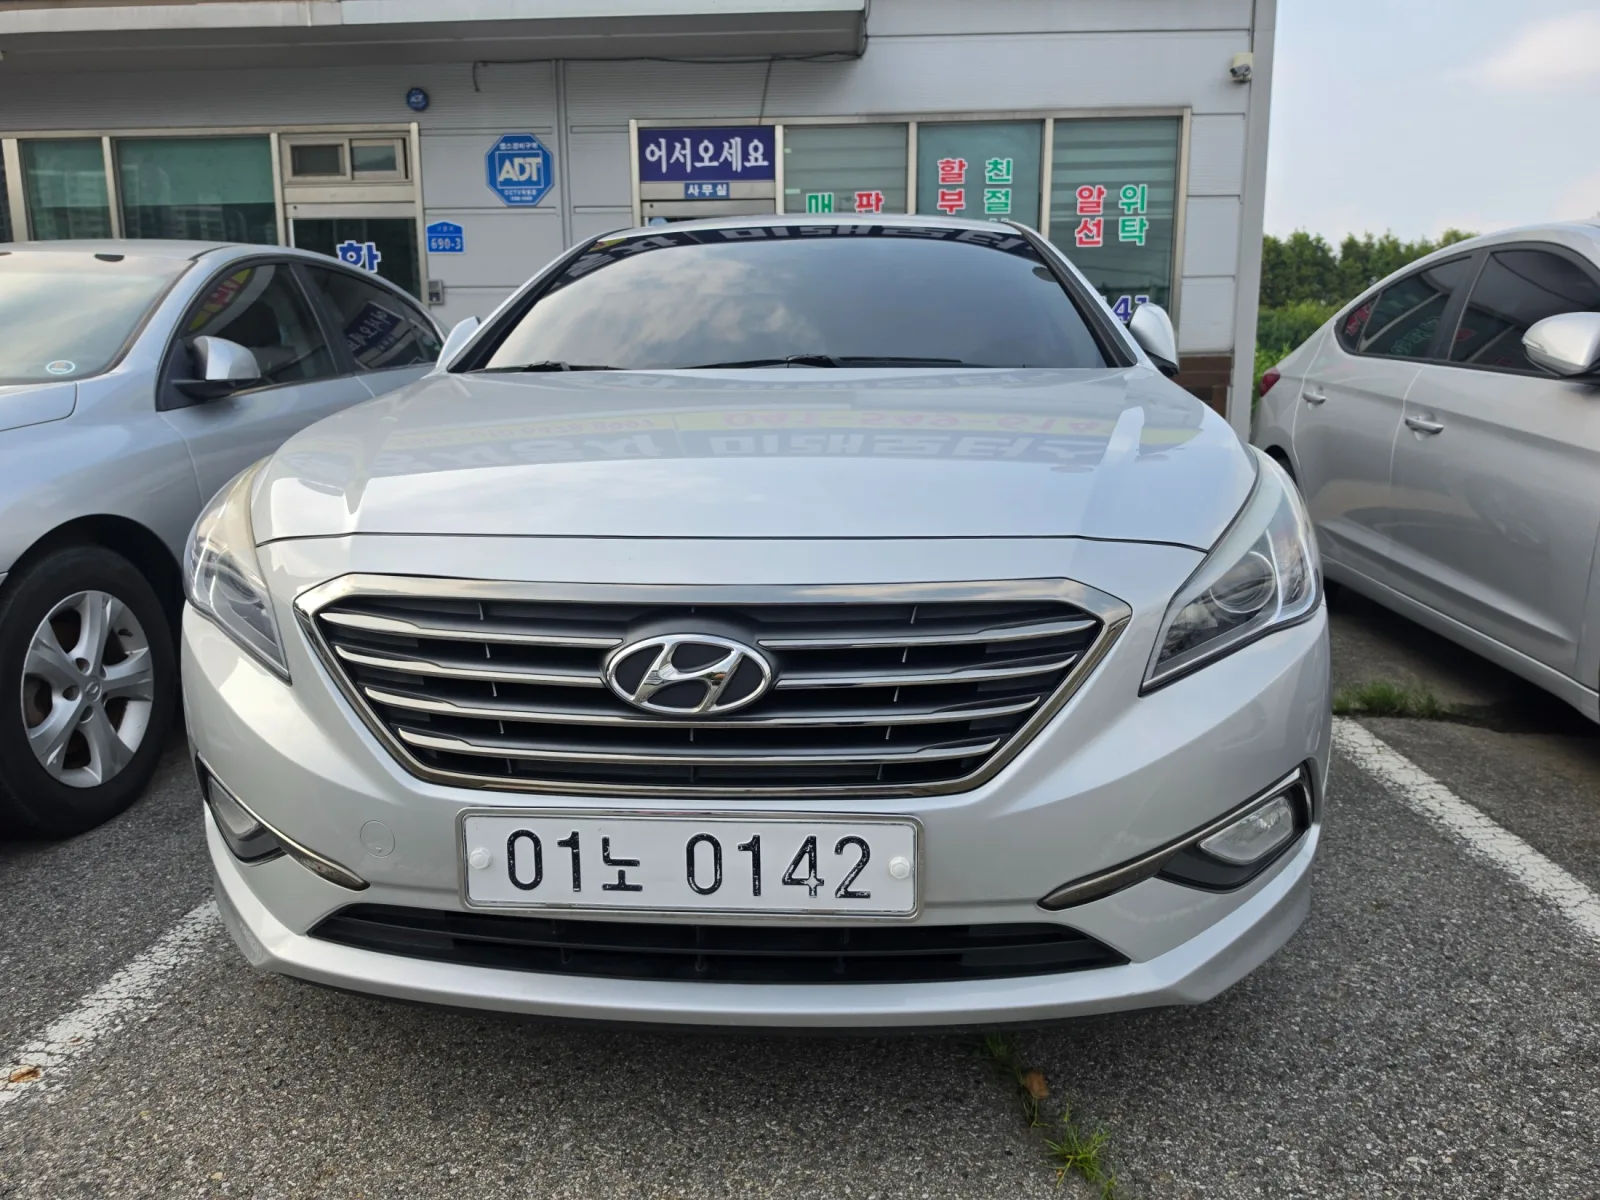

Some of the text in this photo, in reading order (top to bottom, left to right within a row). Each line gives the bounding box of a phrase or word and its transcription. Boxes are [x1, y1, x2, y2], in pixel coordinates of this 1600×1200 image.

[498, 156, 542, 182] ADT
[644, 136, 770, 174] 어서오세요
[687, 183, 727, 197] 사무실
[982, 157, 1014, 222] 친절
[1118, 183, 1150, 246] 위탁
[1075, 184, 1108, 248] 알선
[430, 236, 462, 250] 690-3
[505, 828, 872, 900] 01노 0142
